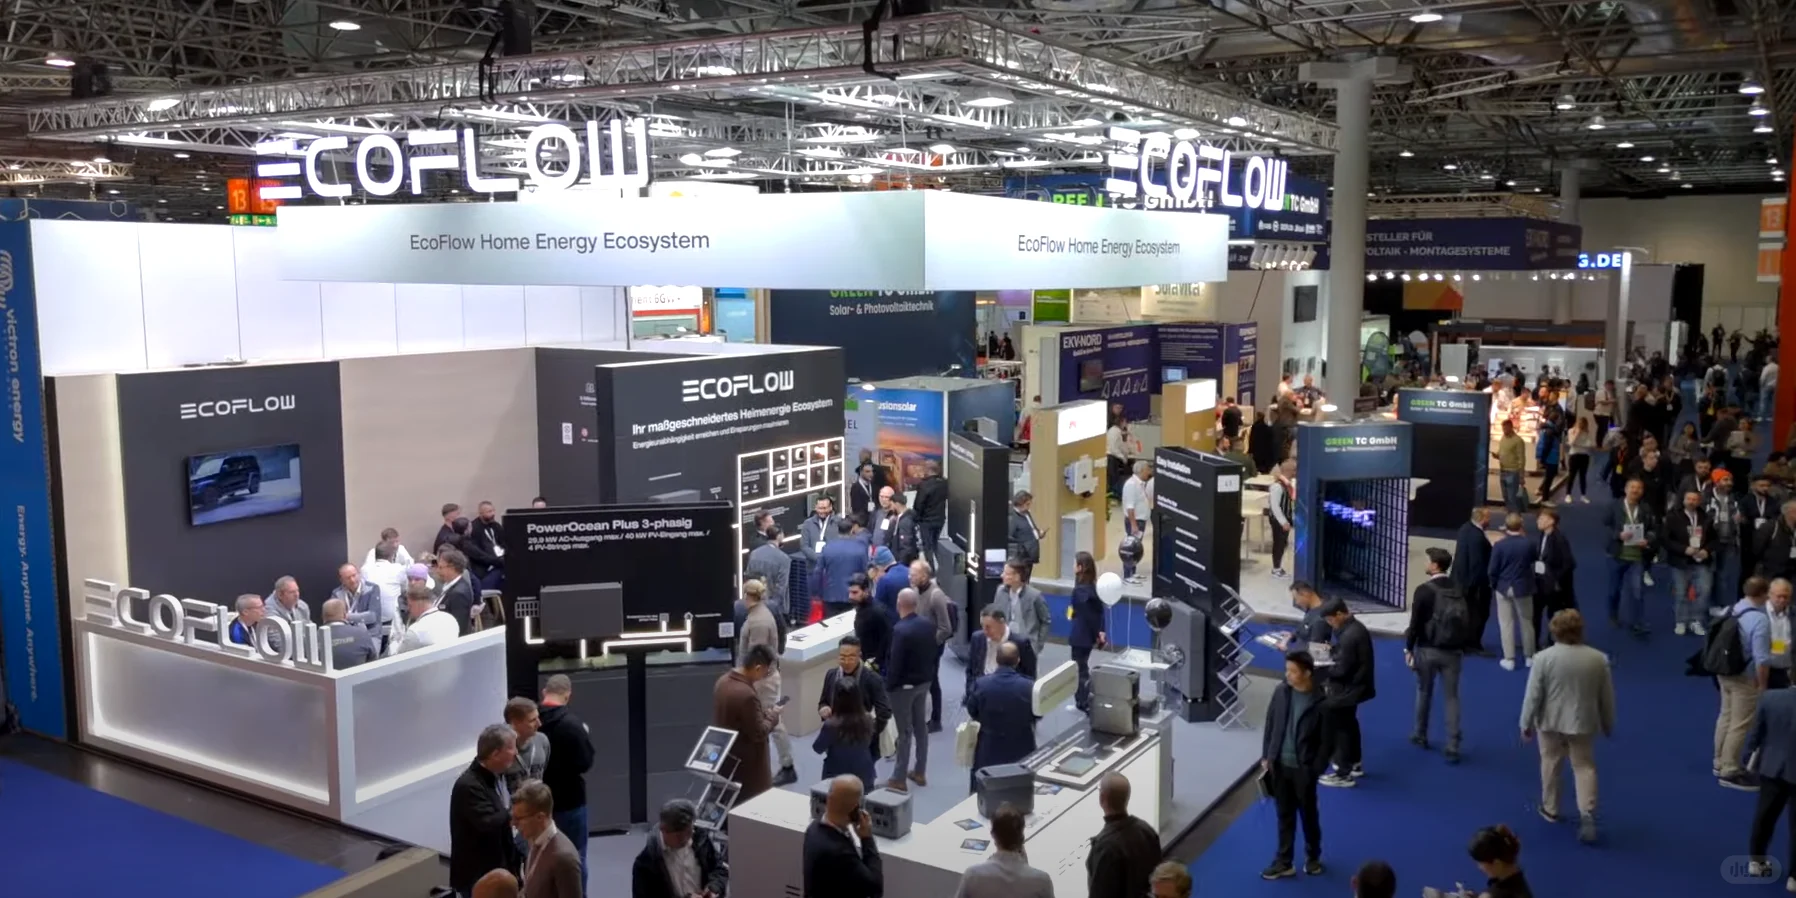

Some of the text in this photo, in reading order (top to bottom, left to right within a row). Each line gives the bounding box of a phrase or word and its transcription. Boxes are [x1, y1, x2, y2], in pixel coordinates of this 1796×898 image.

[256, 118, 650, 199] ECOFLOW
[1106, 126, 1287, 211] ECOFLOW
[232, 189, 247, 211] 13
[410, 232, 710, 253] EcoFlow Home Energy Ecosystem
[1412, 230, 1433, 240] FÜR
[1018, 235, 1180, 258] EcoFlow Home Energy Ecosystem
[1410, 246, 1510, 257] MONTAGESYSTEME
[829, 300, 934, 316] Solar- & Photovoltaiktechnik
[7, 309, 24, 443] victron energy
[682, 370, 794, 402] ECOFLOW
[180, 395, 295, 419] ECOFLOW
[632, 398, 833, 435] Ihr maßgeschneidertes Heimenergie Ecosystem
[878, 402, 917, 412] usionsolar
[720, 427, 730, 436] und
[1355, 437, 1367, 445] TC
[1369, 436, 1398, 445] GmbH
[527, 517, 692, 534] PowerOcean Plus 3-phasig
[85, 578, 332, 674] ECOFLOW
